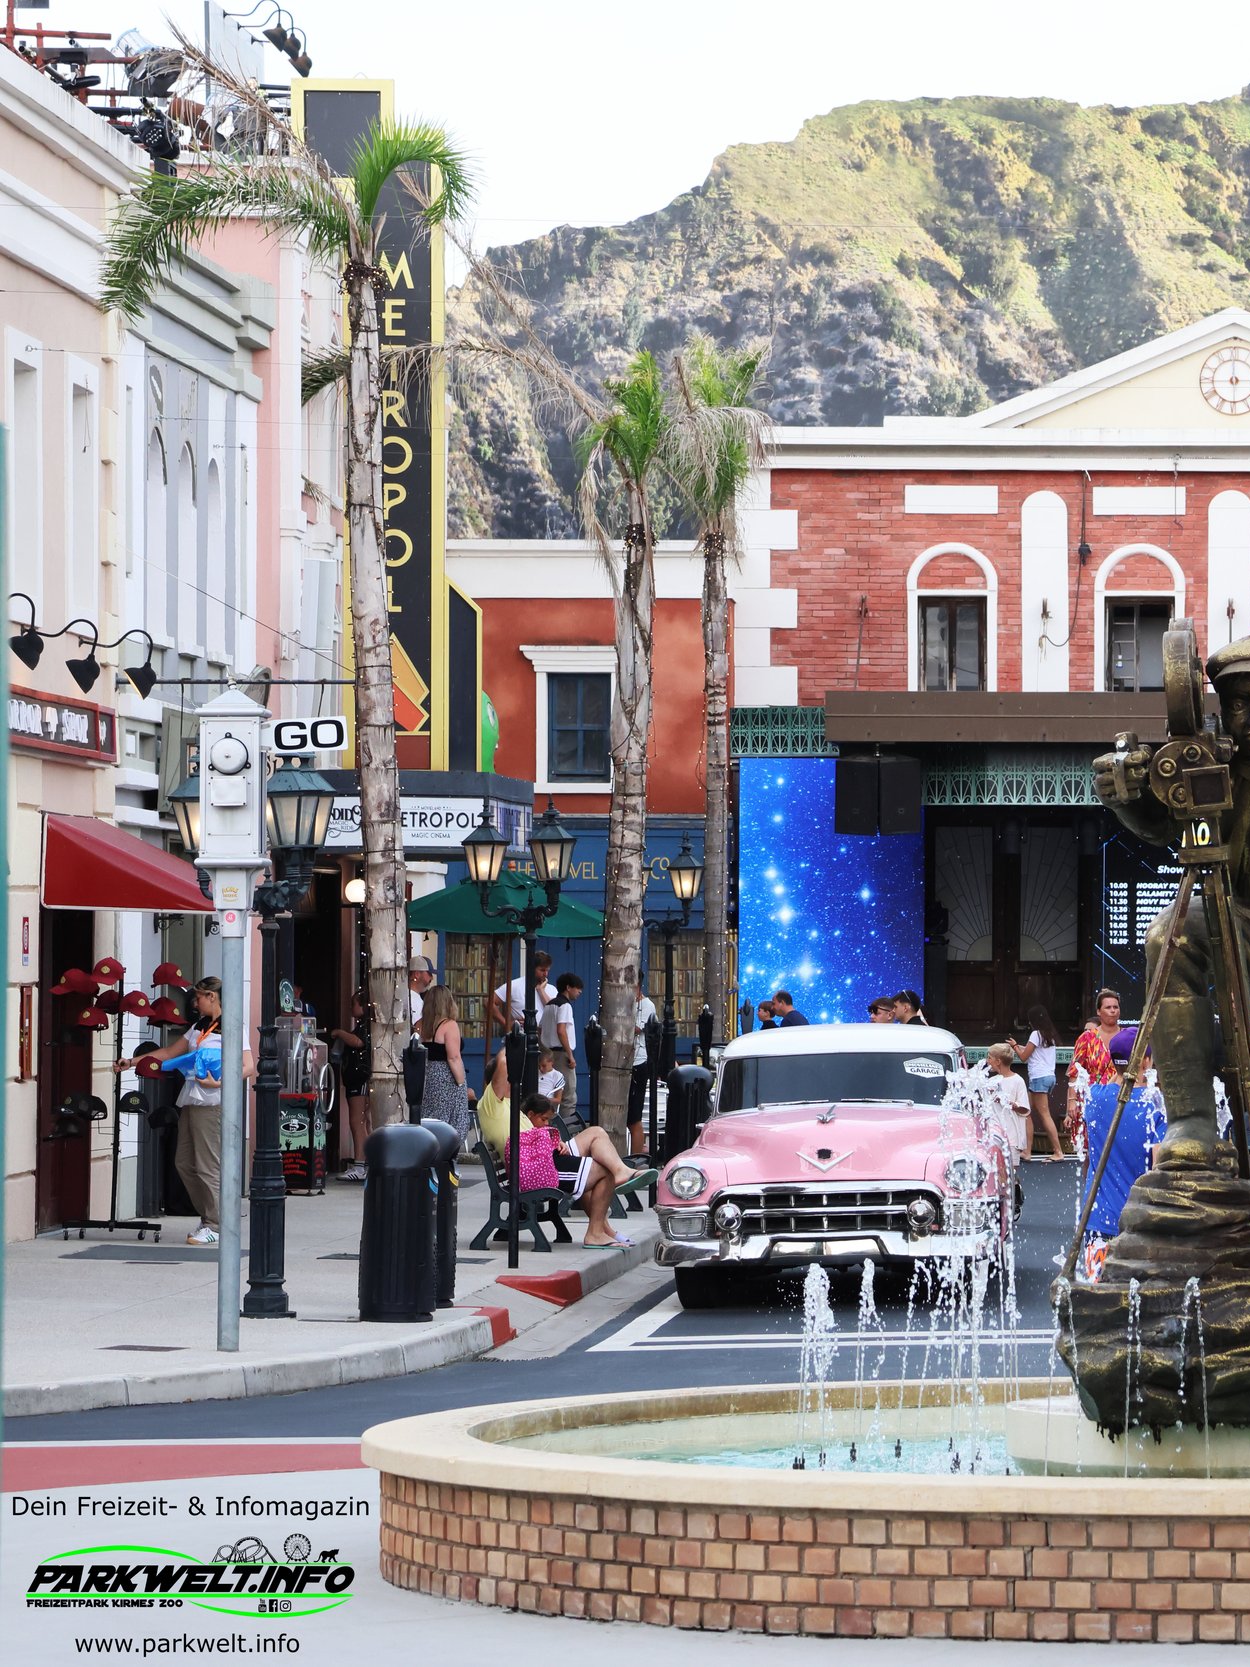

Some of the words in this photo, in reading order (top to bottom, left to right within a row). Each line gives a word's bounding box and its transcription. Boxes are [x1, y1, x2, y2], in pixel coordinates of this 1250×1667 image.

[274, 719, 345, 751] GO
[401, 811, 478, 828] ETROPOL
[910, 1067, 941, 1076] GARAGE
